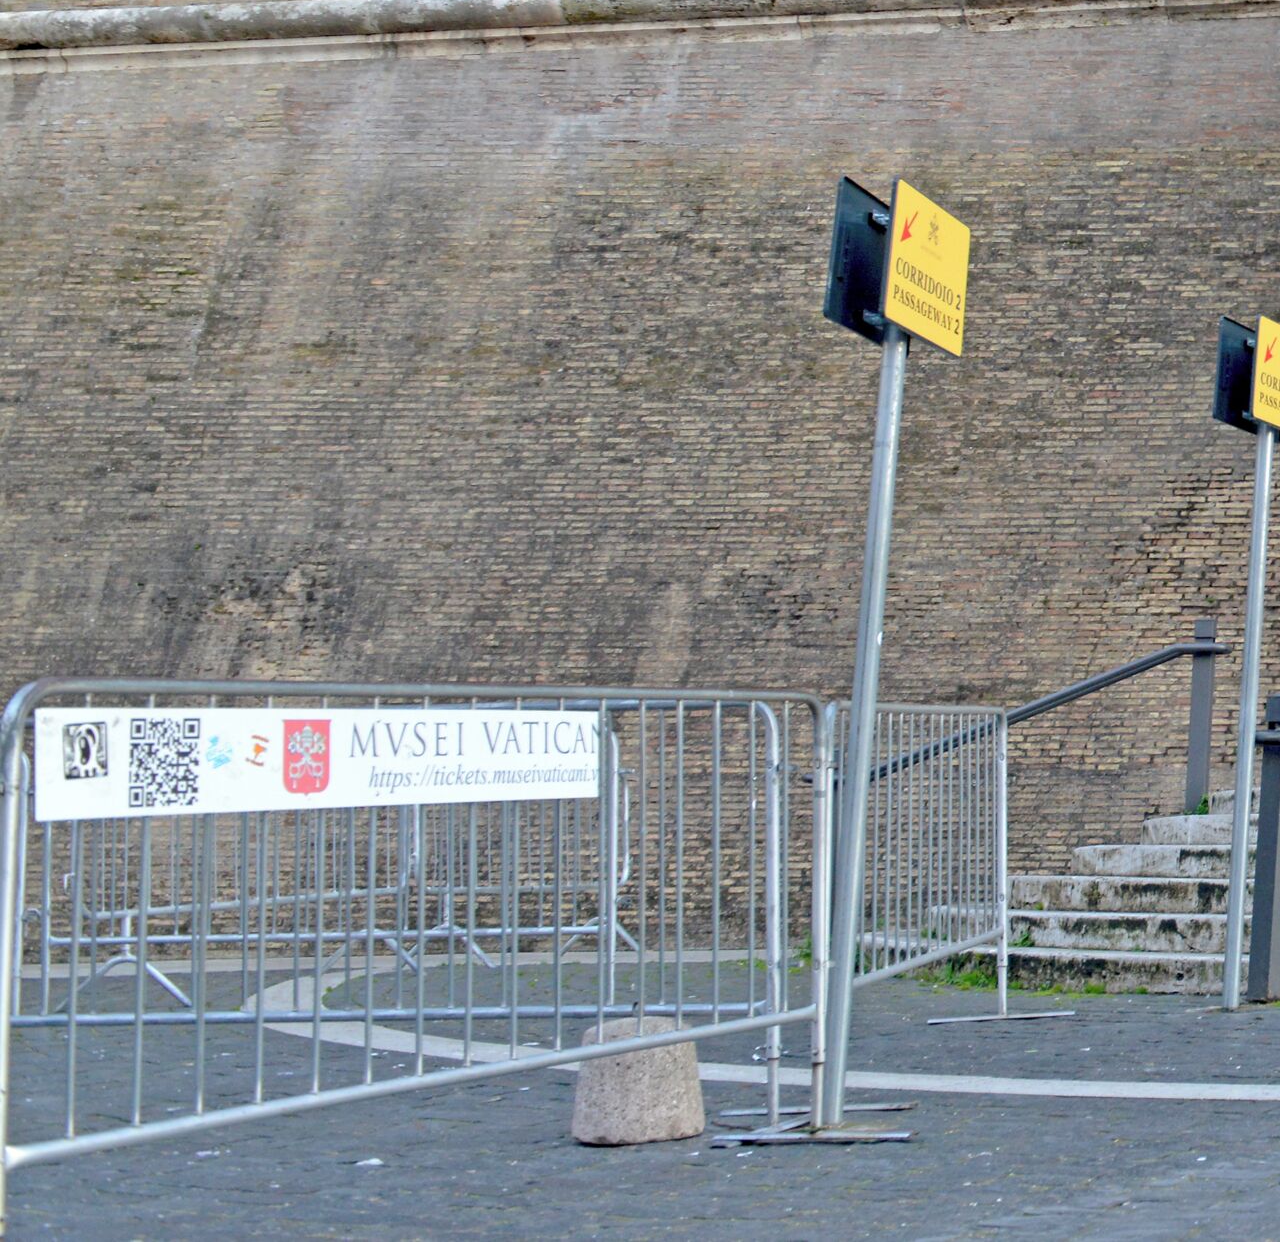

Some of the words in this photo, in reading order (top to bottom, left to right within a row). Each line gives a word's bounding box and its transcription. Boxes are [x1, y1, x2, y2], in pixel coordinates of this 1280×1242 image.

[892, 284, 954, 331] PASSAGEWAY
[954, 319, 960, 335] 2
[895, 257, 954, 306] CORRIDOIO
[955, 294, 961, 311] 2
[349, 721, 465, 757] MVSEI
